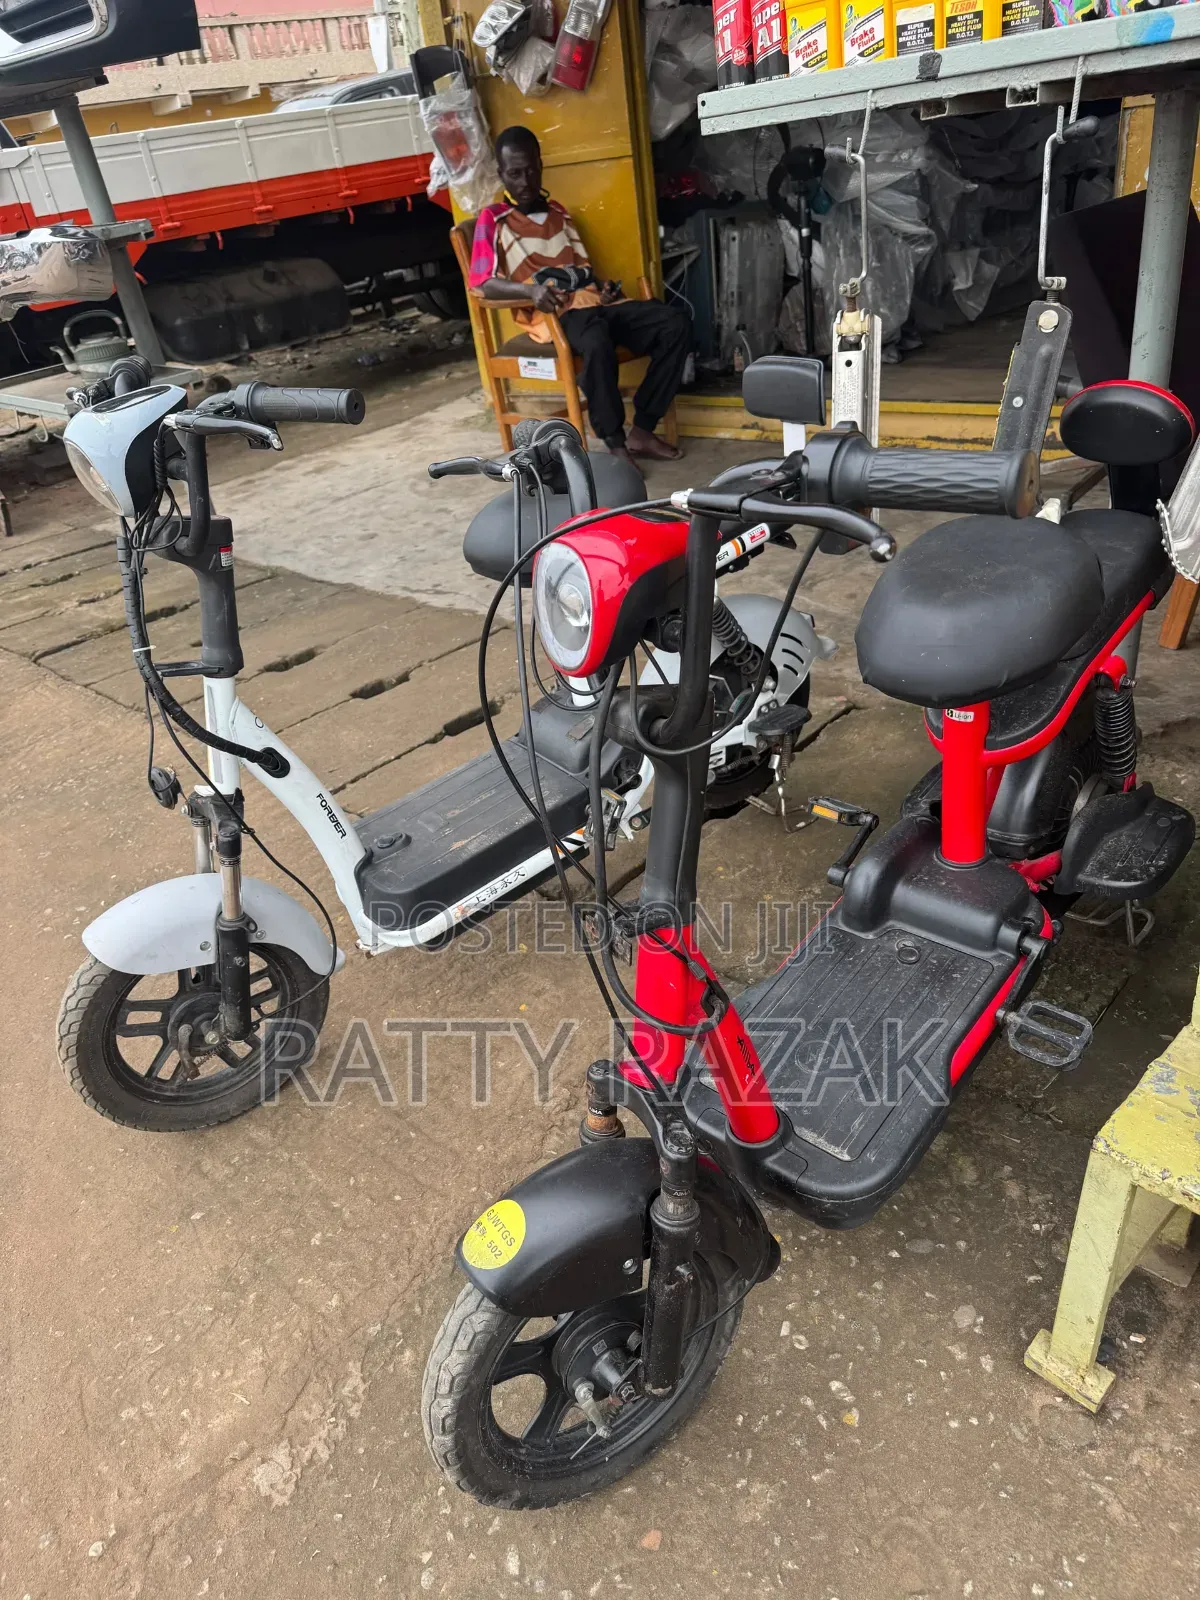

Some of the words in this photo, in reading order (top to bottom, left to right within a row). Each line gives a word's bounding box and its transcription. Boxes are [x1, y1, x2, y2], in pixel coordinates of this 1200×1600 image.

[1012, 0, 1030, 8] SUPER
[715, 8, 737, 35] per
[957, 13, 974, 21] SUPER
[1002, 13, 1021, 22] BRAKE
[1022, 10, 1040, 18] FLUID
[907, 22, 924, 30] SUPER
[948, 26, 966, 34] BRAKE
[967, 23, 982, 31] FLUID
[756, 18, 782, 54] A1
[850, 27, 875, 47] Brake
[857, 34, 876, 50] Fluid
[898, 35, 917, 43] BRAKE
[917, 32, 933, 40] FLUID
[794, 39, 818, 58] Brake
[801, 46, 819, 61] Fluid
[473, 871, 526, 907] 上海永久
[486, 1240, 503, 1259] 502
